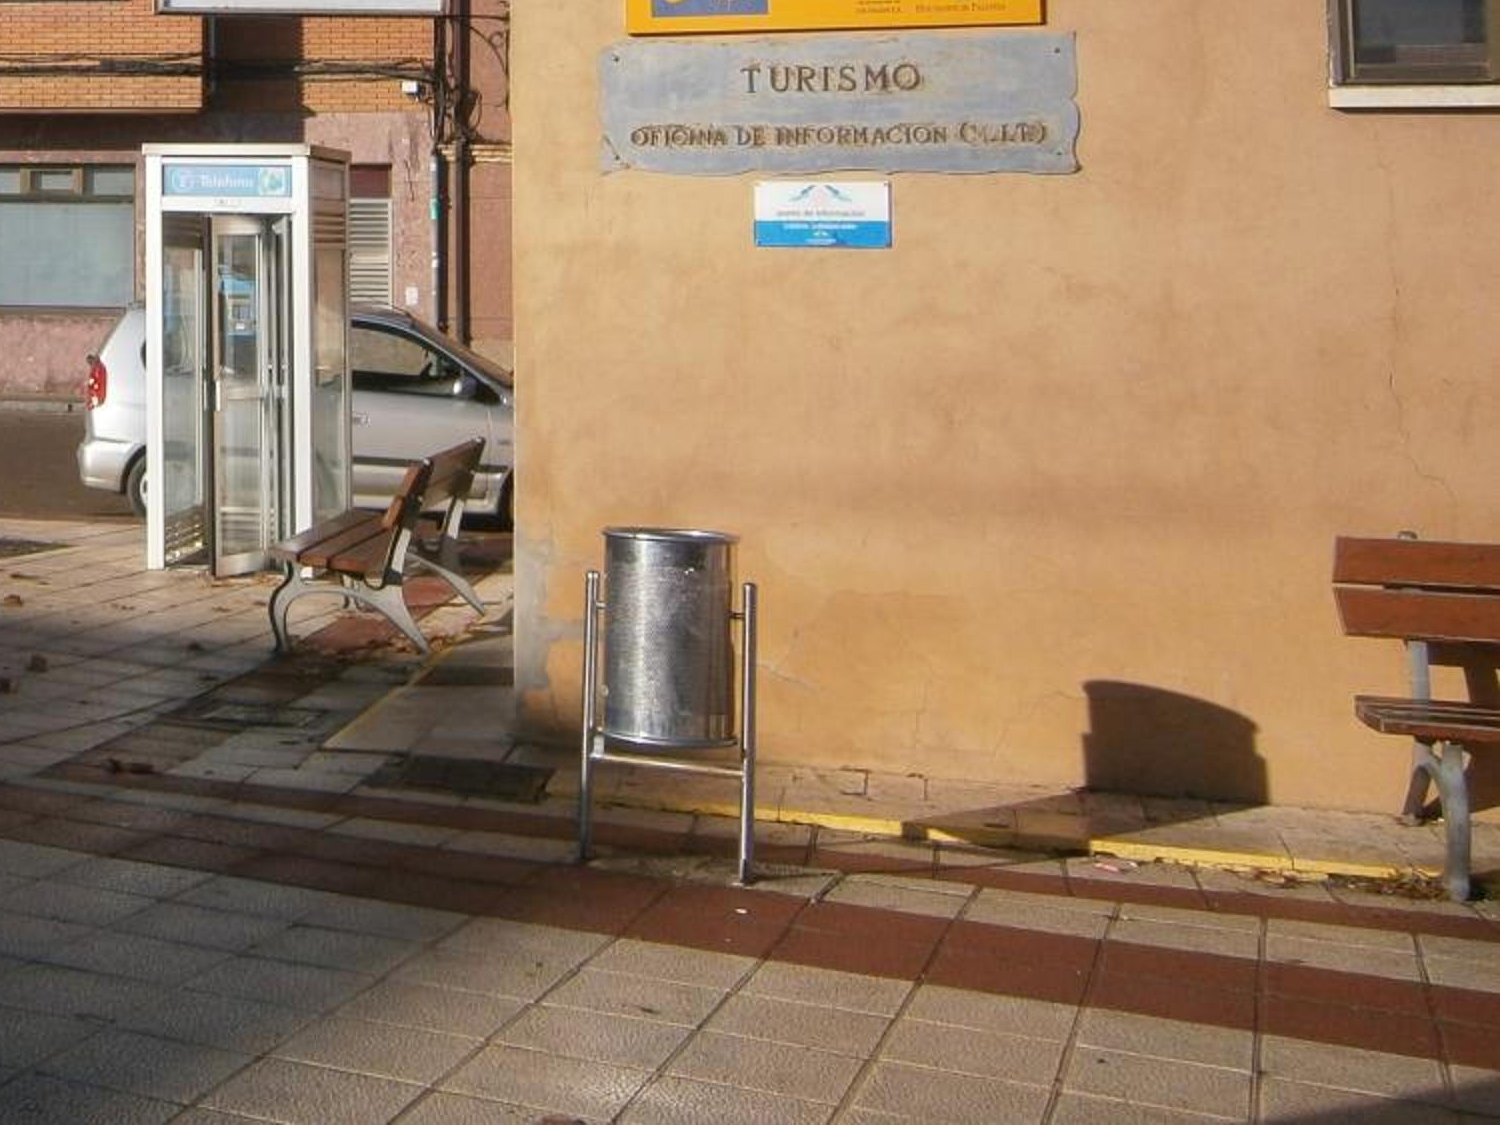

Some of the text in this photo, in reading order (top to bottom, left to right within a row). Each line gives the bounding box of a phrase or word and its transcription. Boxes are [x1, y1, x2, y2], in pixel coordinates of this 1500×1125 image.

[740, 63, 921, 94] TURISMO
[631, 125, 727, 147] OFICINA
[736, 126, 765, 146] DE
